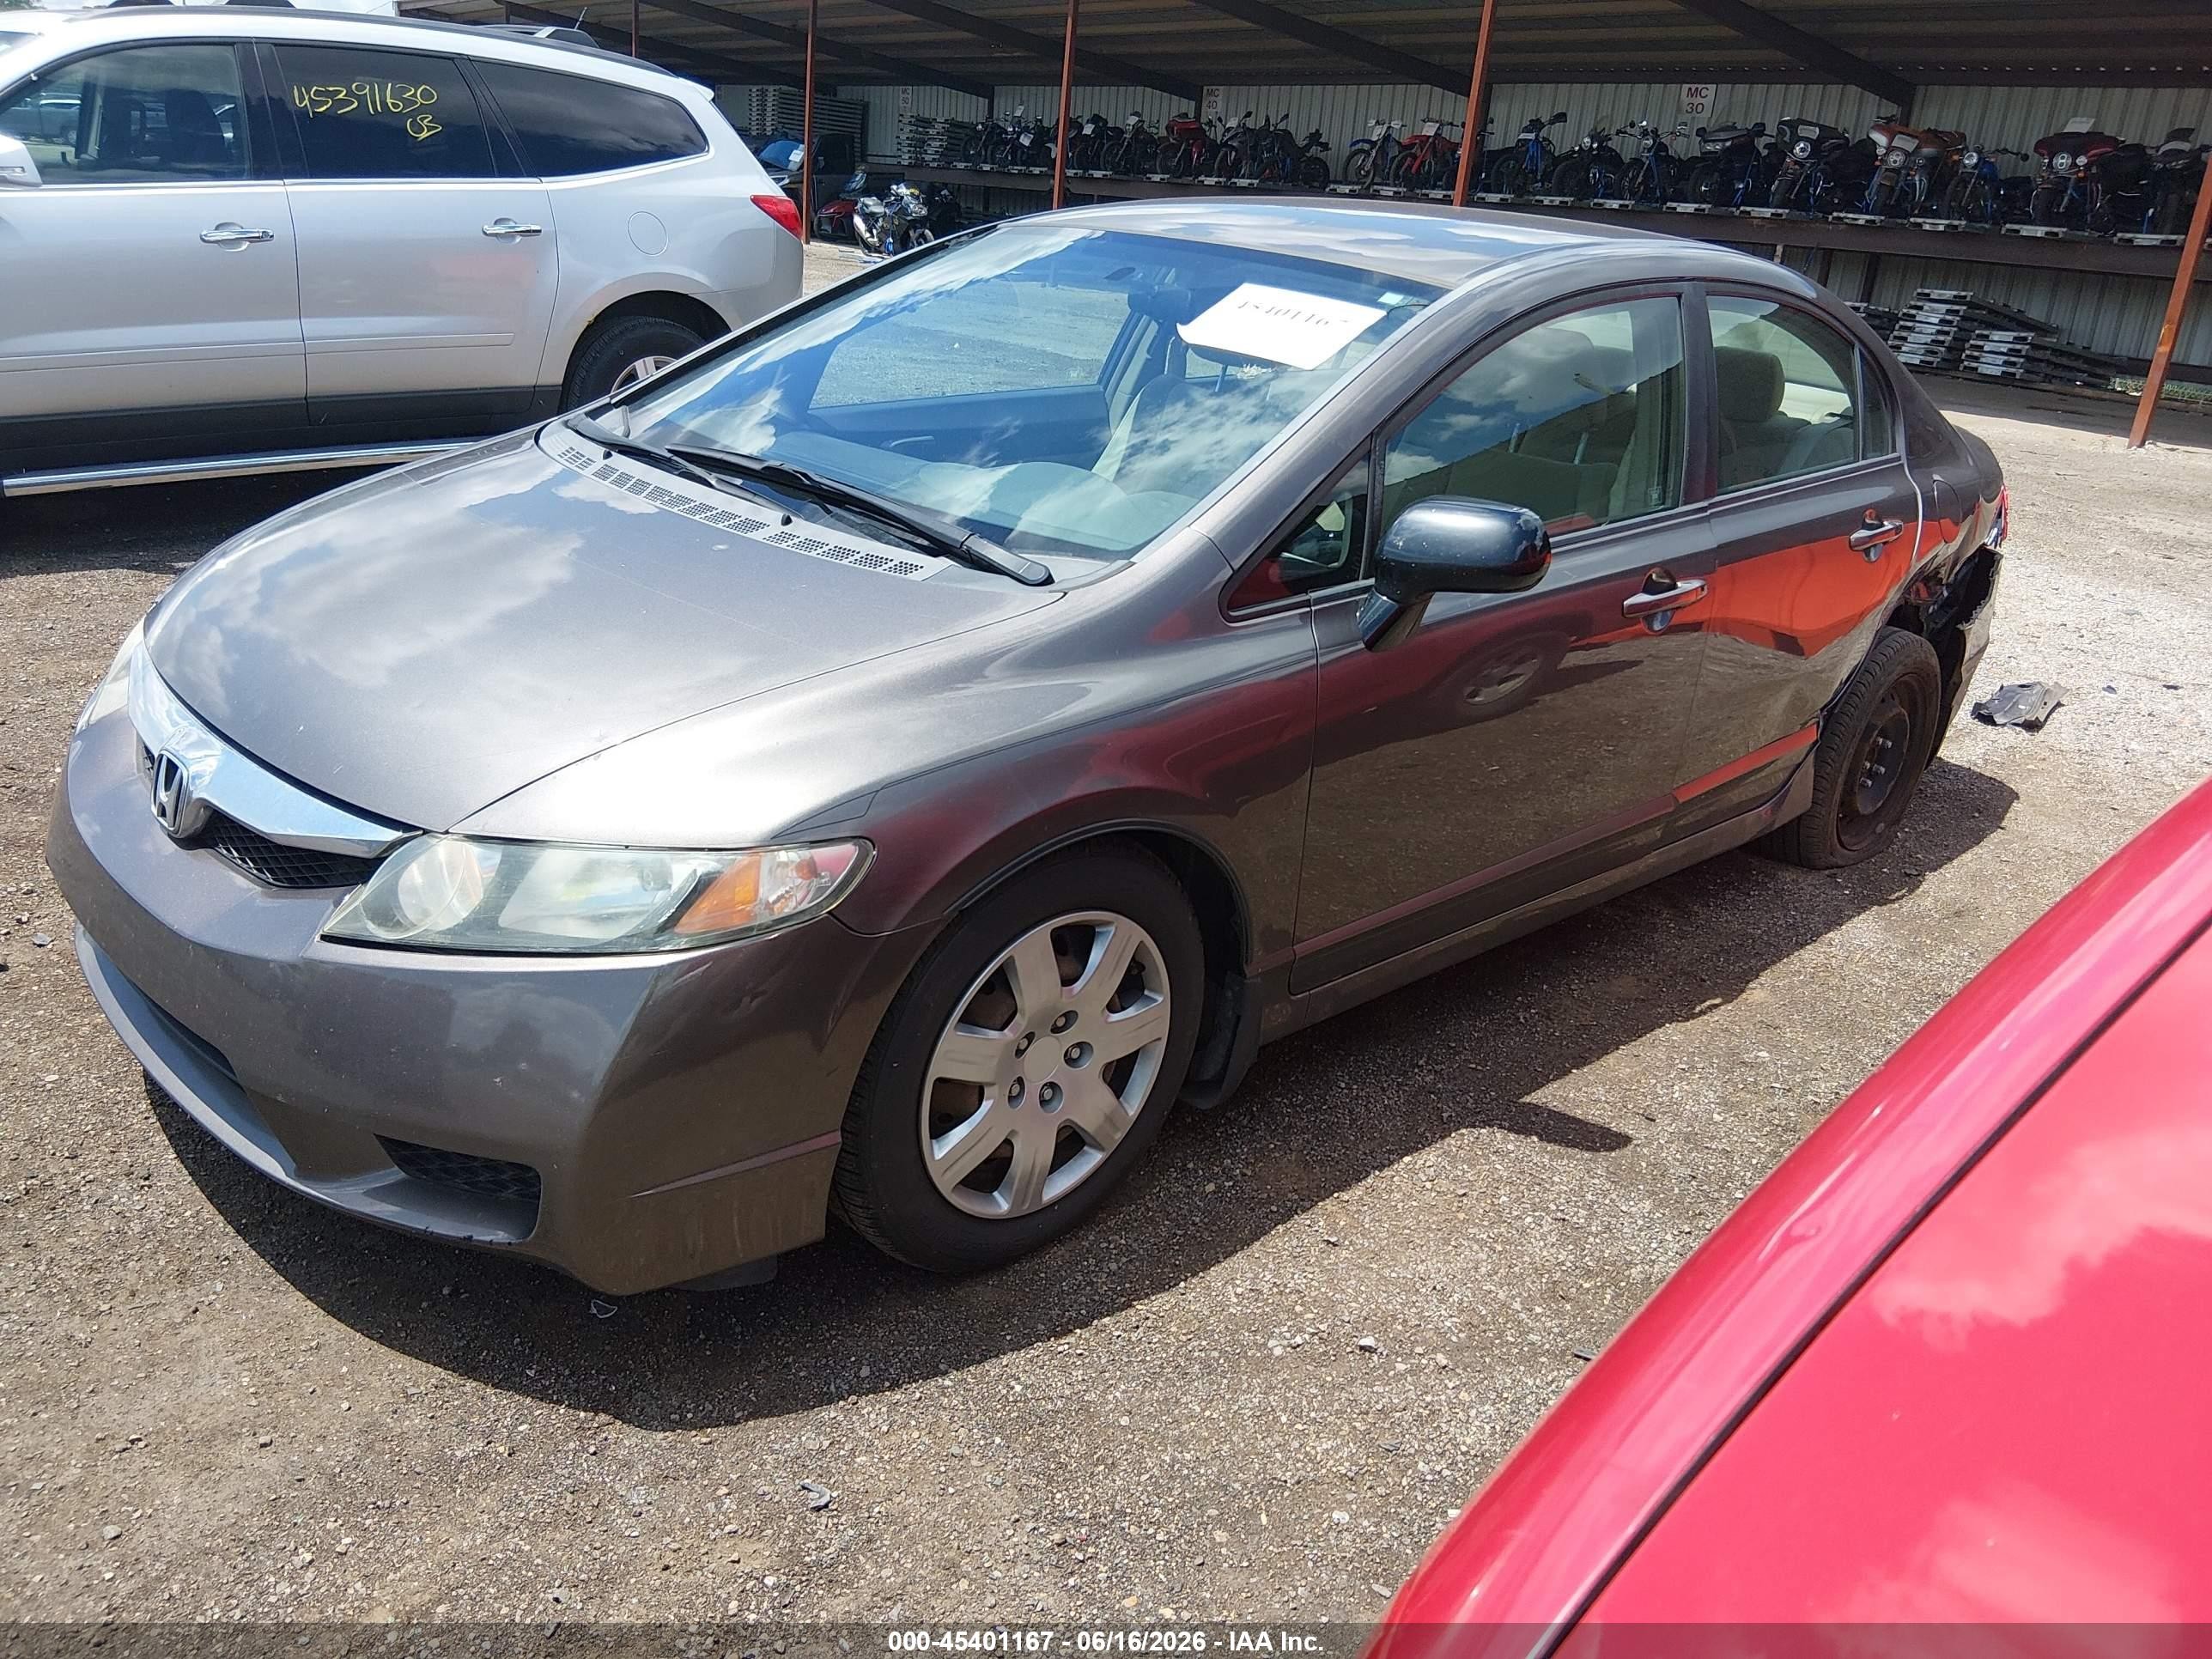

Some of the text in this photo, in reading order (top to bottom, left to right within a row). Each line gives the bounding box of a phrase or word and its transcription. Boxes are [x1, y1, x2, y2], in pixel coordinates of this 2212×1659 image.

[1206, 88, 1219, 97] MC
[1686, 87, 1710, 99] MC
[293, 82, 438, 118] 45391630
[1206, 100, 1218, 110] 40
[1685, 102, 1705, 114] 30
